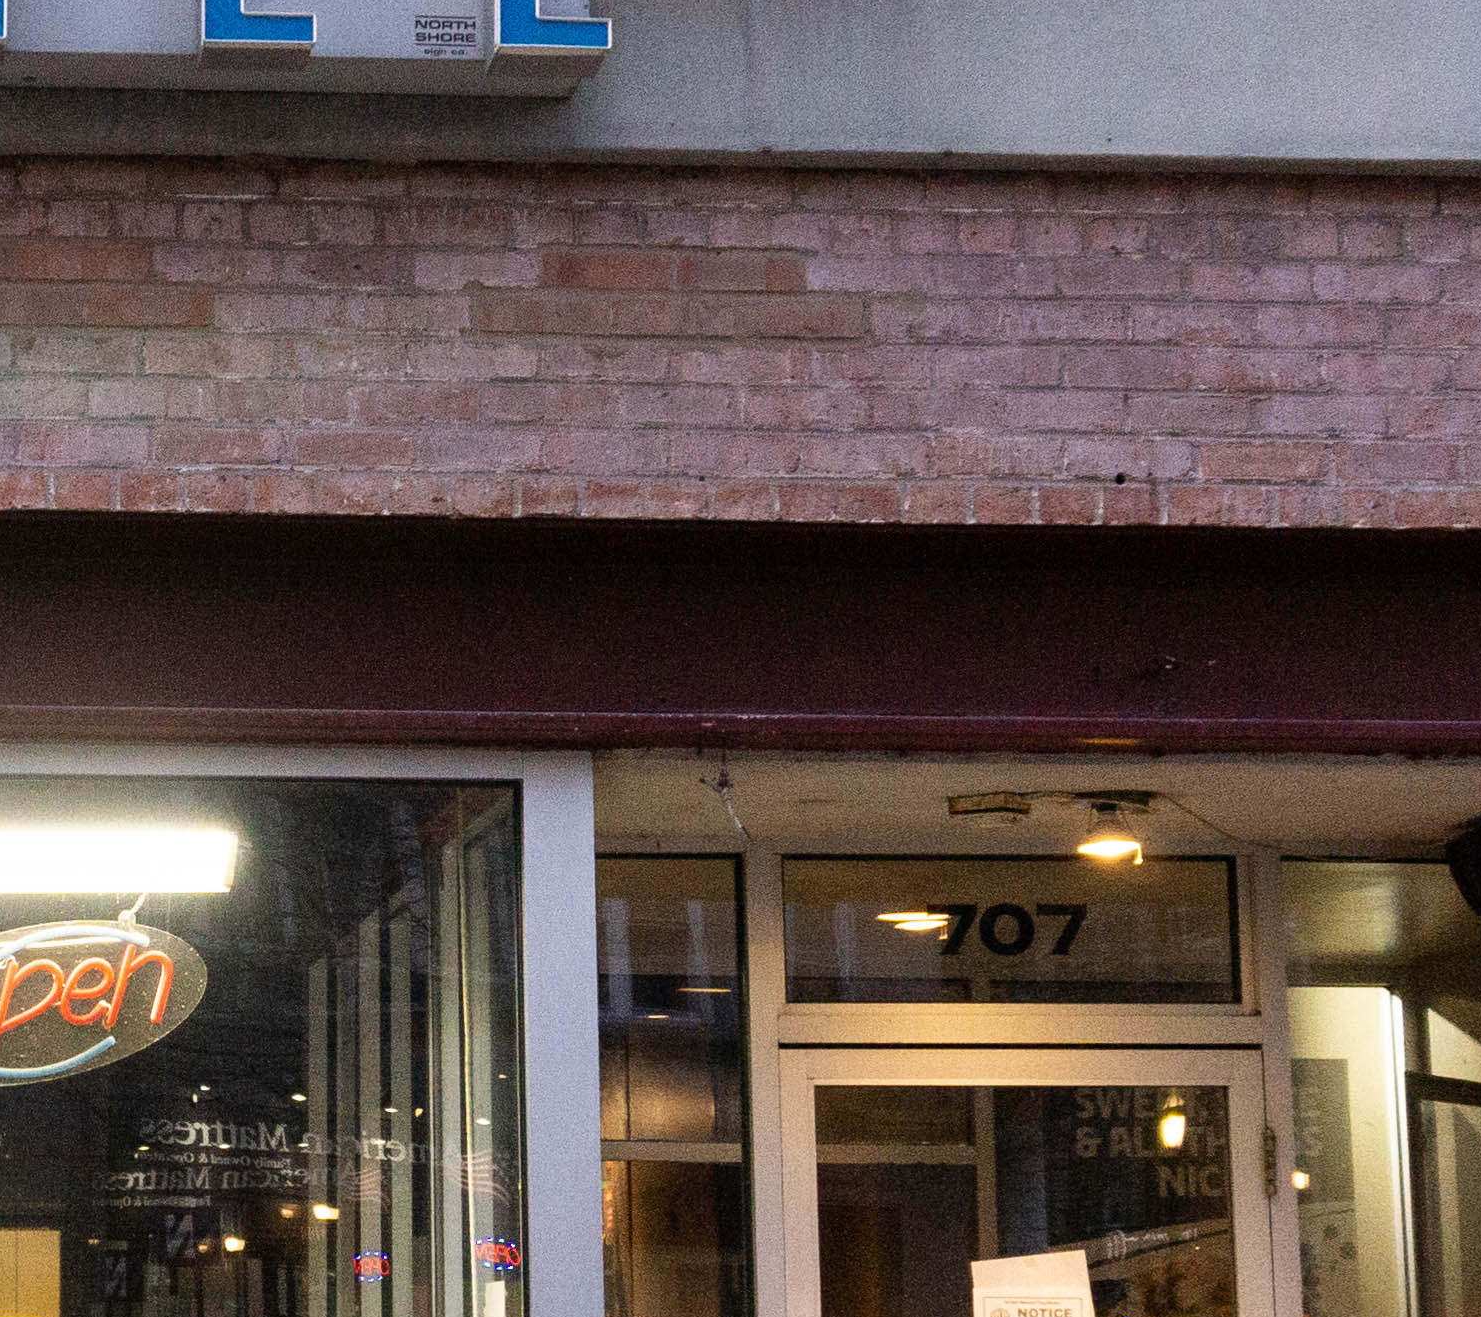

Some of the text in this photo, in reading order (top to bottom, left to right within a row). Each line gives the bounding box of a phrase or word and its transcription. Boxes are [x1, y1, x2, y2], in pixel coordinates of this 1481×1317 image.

[414, 19, 477, 30] NORTH
[415, 32, 477, 43] SHORE
[927, 903, 1088, 956] 707
